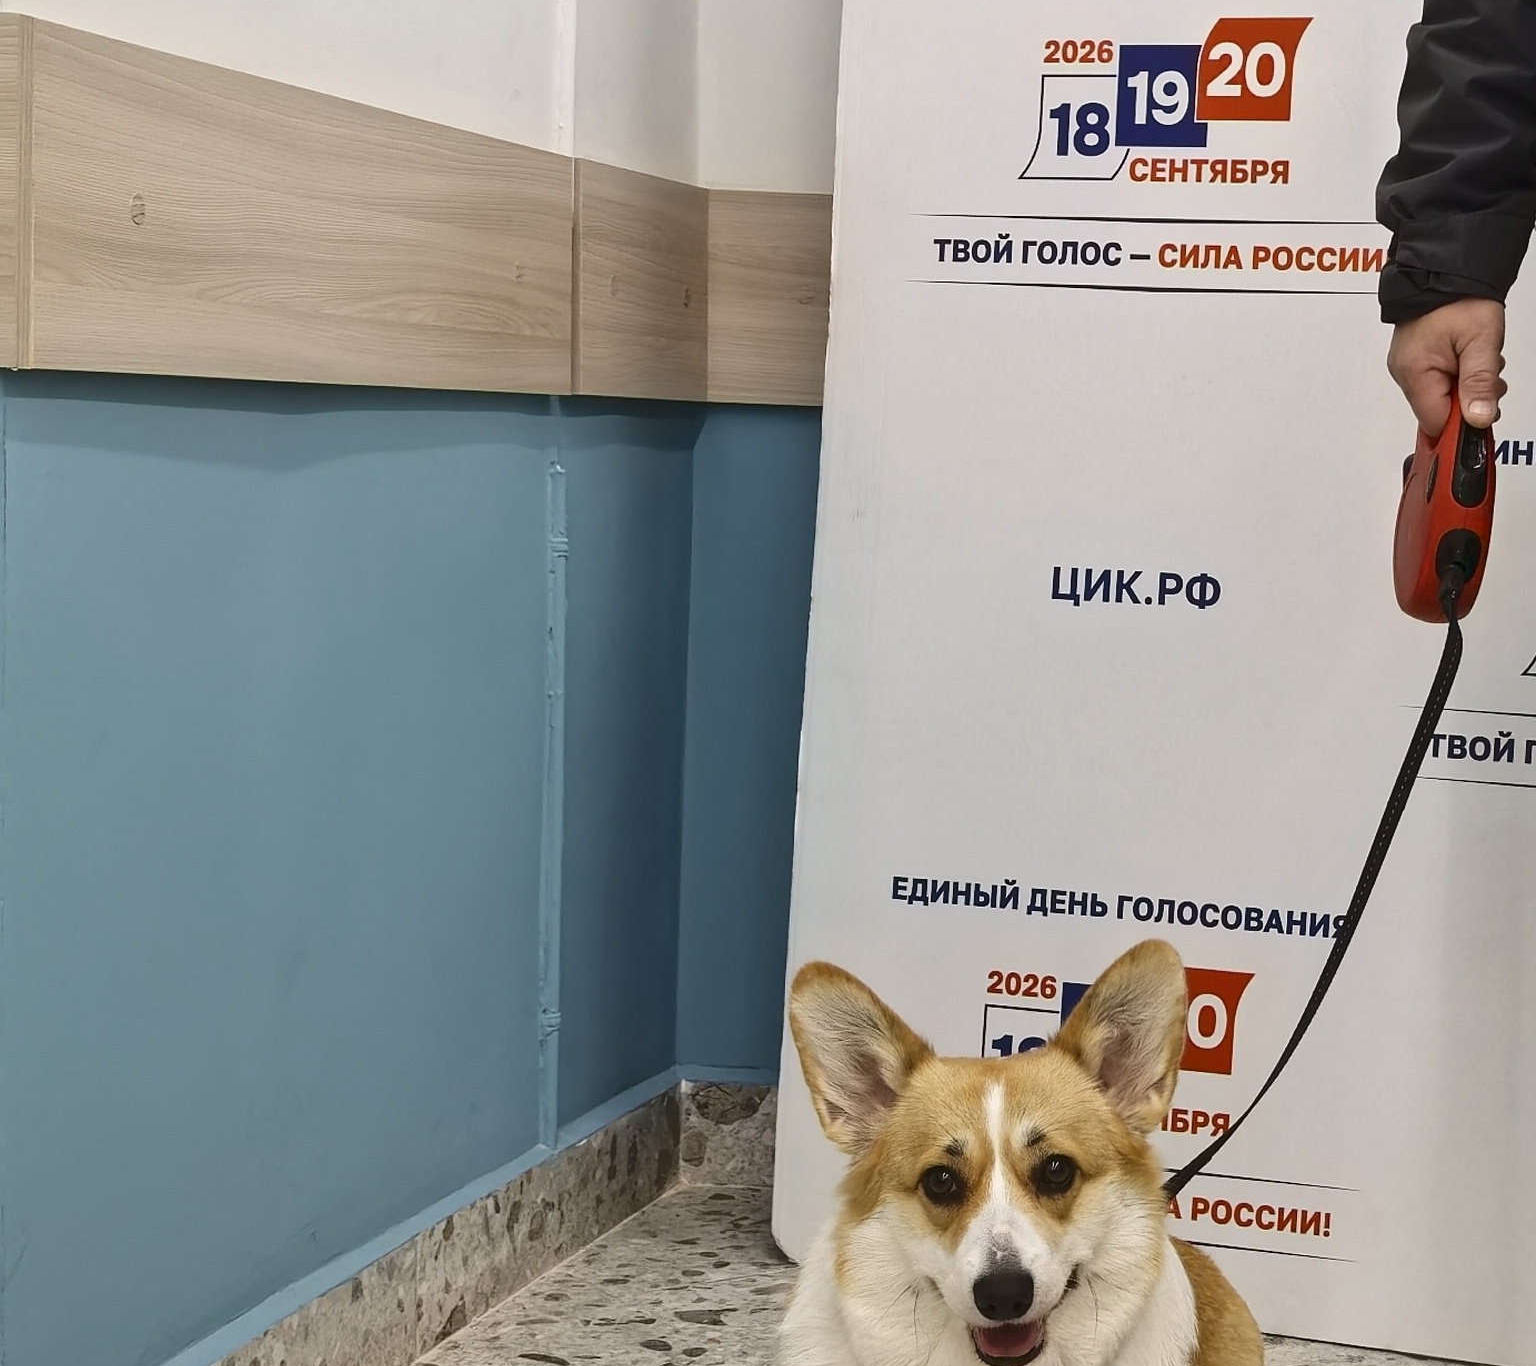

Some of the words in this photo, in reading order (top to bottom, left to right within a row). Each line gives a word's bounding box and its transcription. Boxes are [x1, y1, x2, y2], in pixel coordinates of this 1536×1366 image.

[1043, 39, 1114, 64] 2026
[1206, 41, 1287, 98] 20
[1127, 70, 1190, 126] 19
[1049, 102, 1111, 157] 18
[1129, 158, 1290, 185] СЕНТЯБРЯ
[933, 233, 1014, 264] ТВОЙ
[1021, 240, 1123, 267] ГОЛОС
[1158, 243, 1244, 270] СИЛА
[1252, 246, 1383, 272] РОССИИ
[1051, 566, 1221, 610] ЦИК.РФ
[1432, 731, 1515, 763] ТВОЙ
[891, 876, 1020, 911] ЕДИНЫЙ
[1025, 887, 1108, 918] ДЕНЬ
[1116, 897, 1348, 939] ГОЛОСОВАНИЯ
[986, 970, 1057, 1000] 2026
[1187, 994, 1227, 1048] 0
[1190, 1196, 1331, 1238] РОССИИ!
